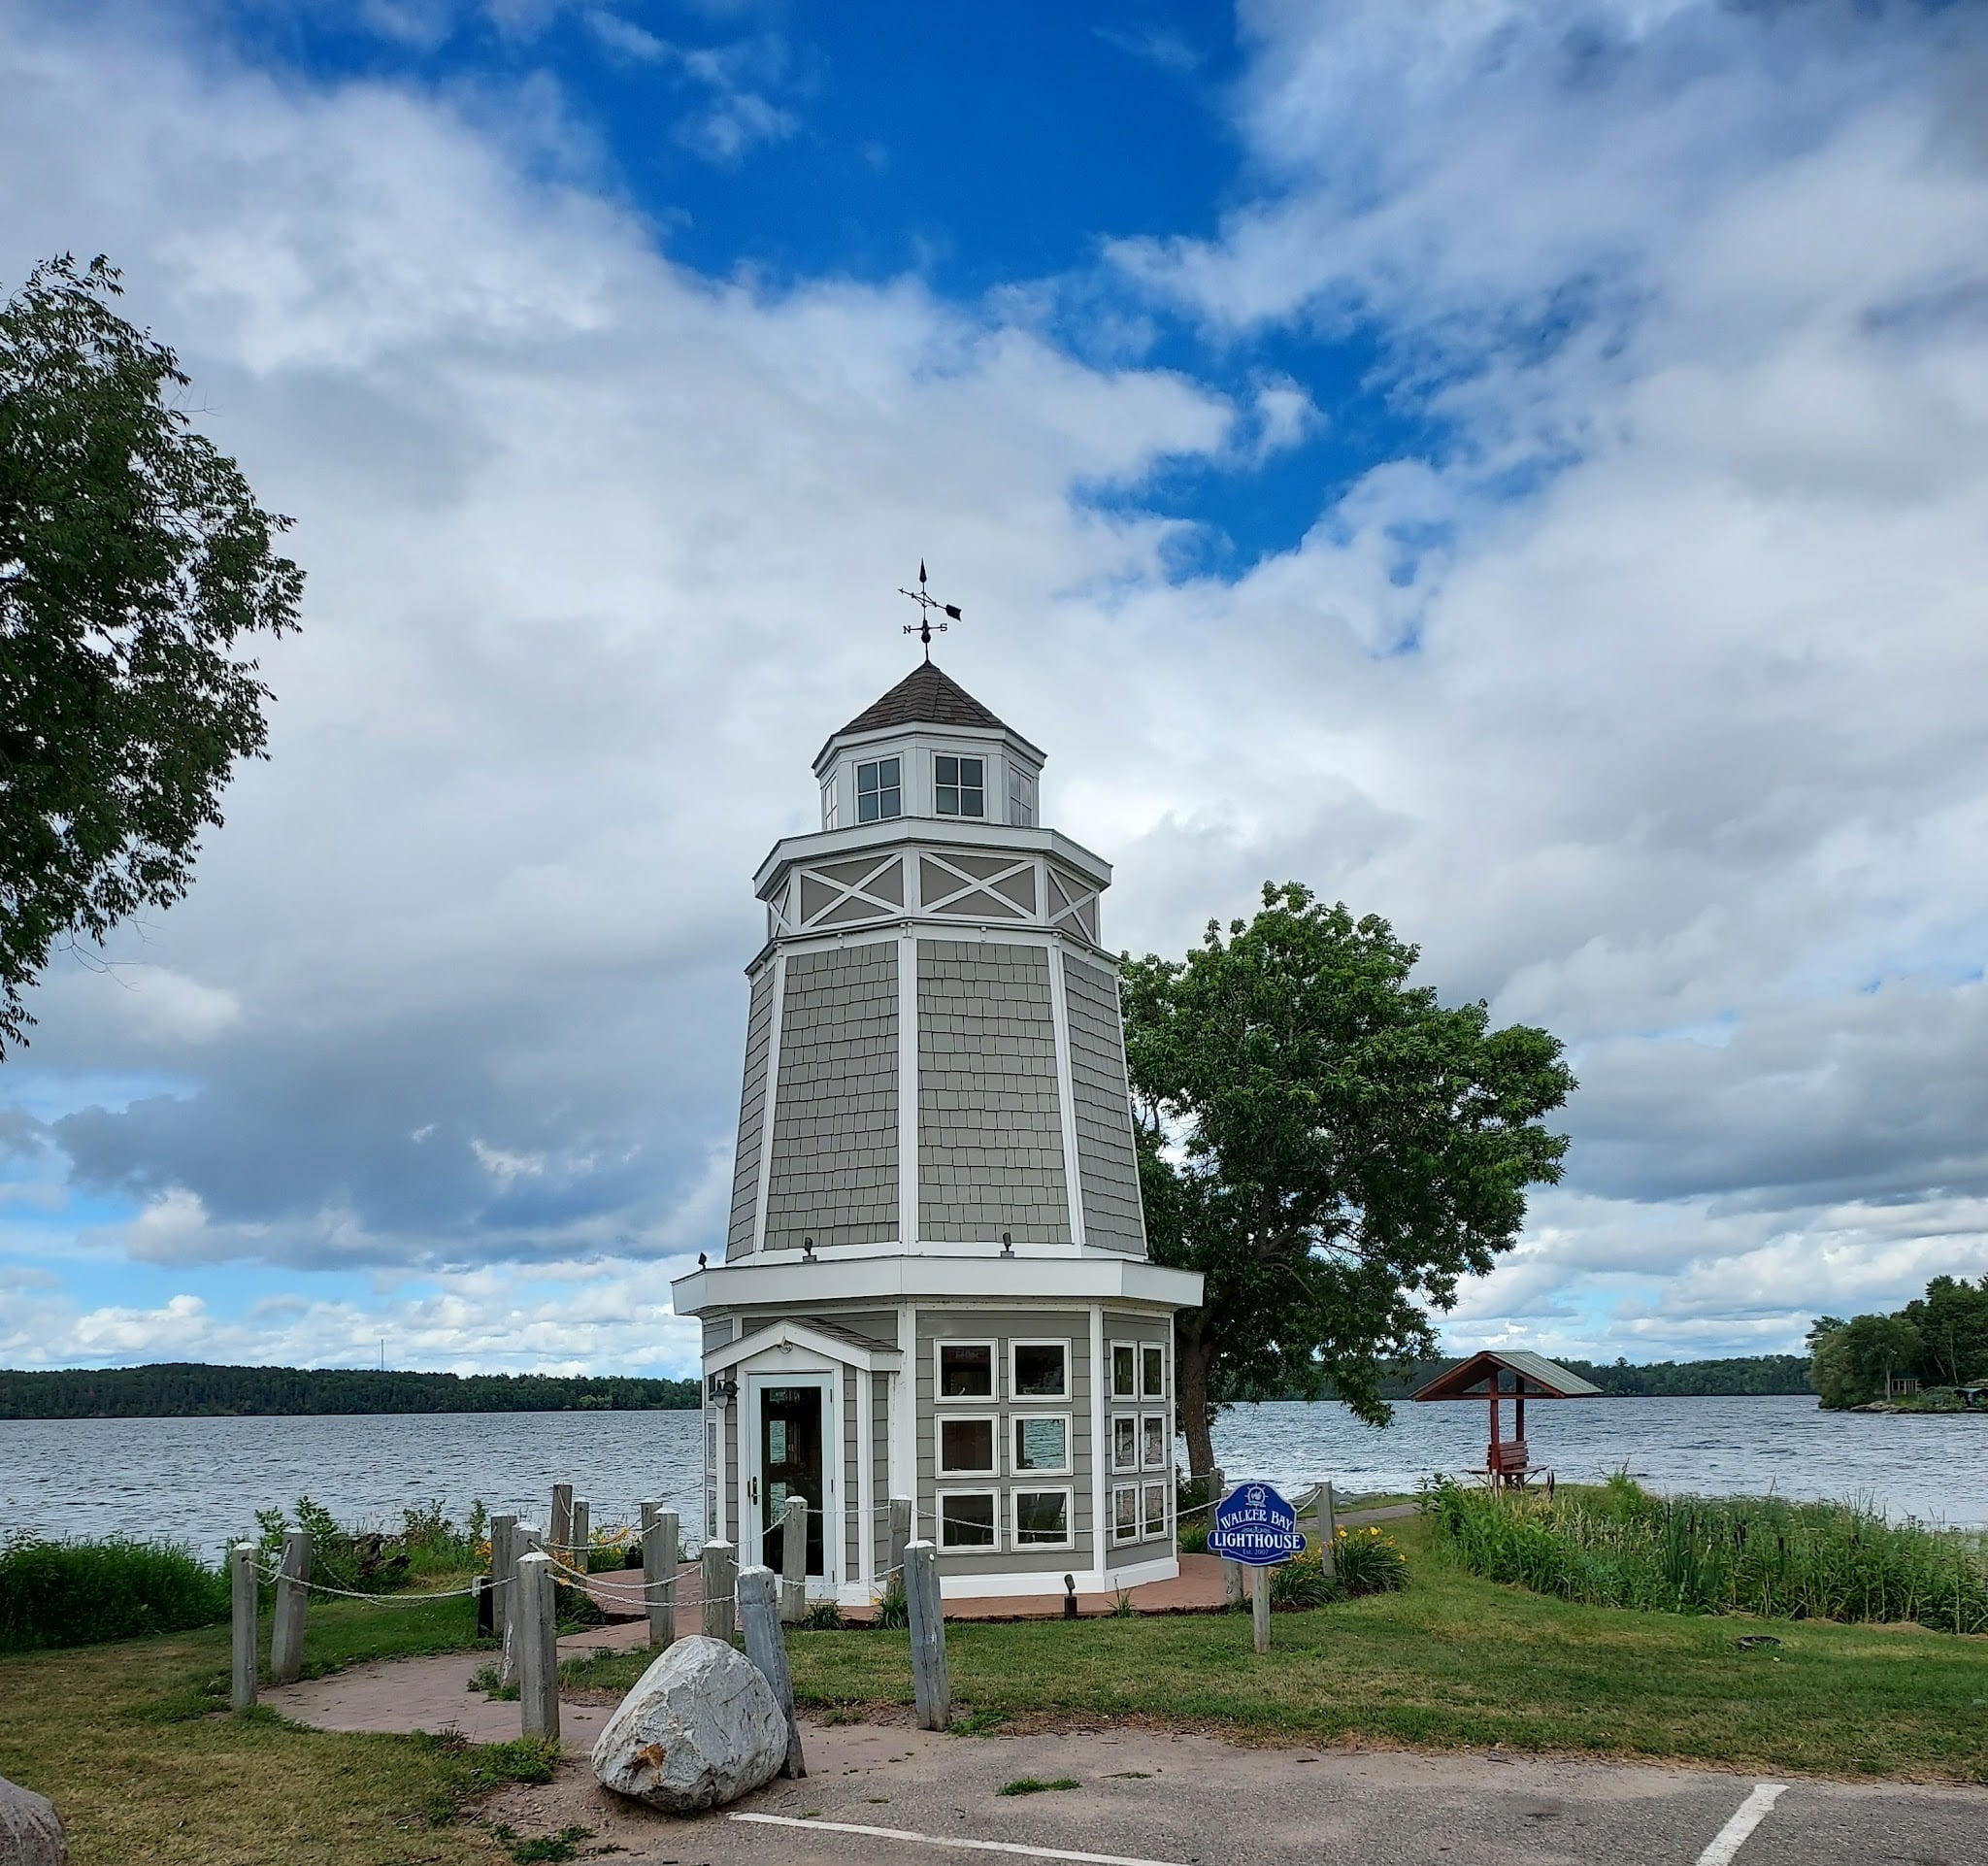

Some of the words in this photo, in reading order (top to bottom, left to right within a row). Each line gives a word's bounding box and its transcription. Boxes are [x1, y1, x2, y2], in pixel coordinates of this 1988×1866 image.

[903, 625, 911, 634] N
[940, 623, 948, 632] S
[1220, 1509, 1268, 1530] WALKER
[1271, 1511, 1293, 1531] BAY
[1214, 1532, 1301, 1549] LIGHTHOUSE
